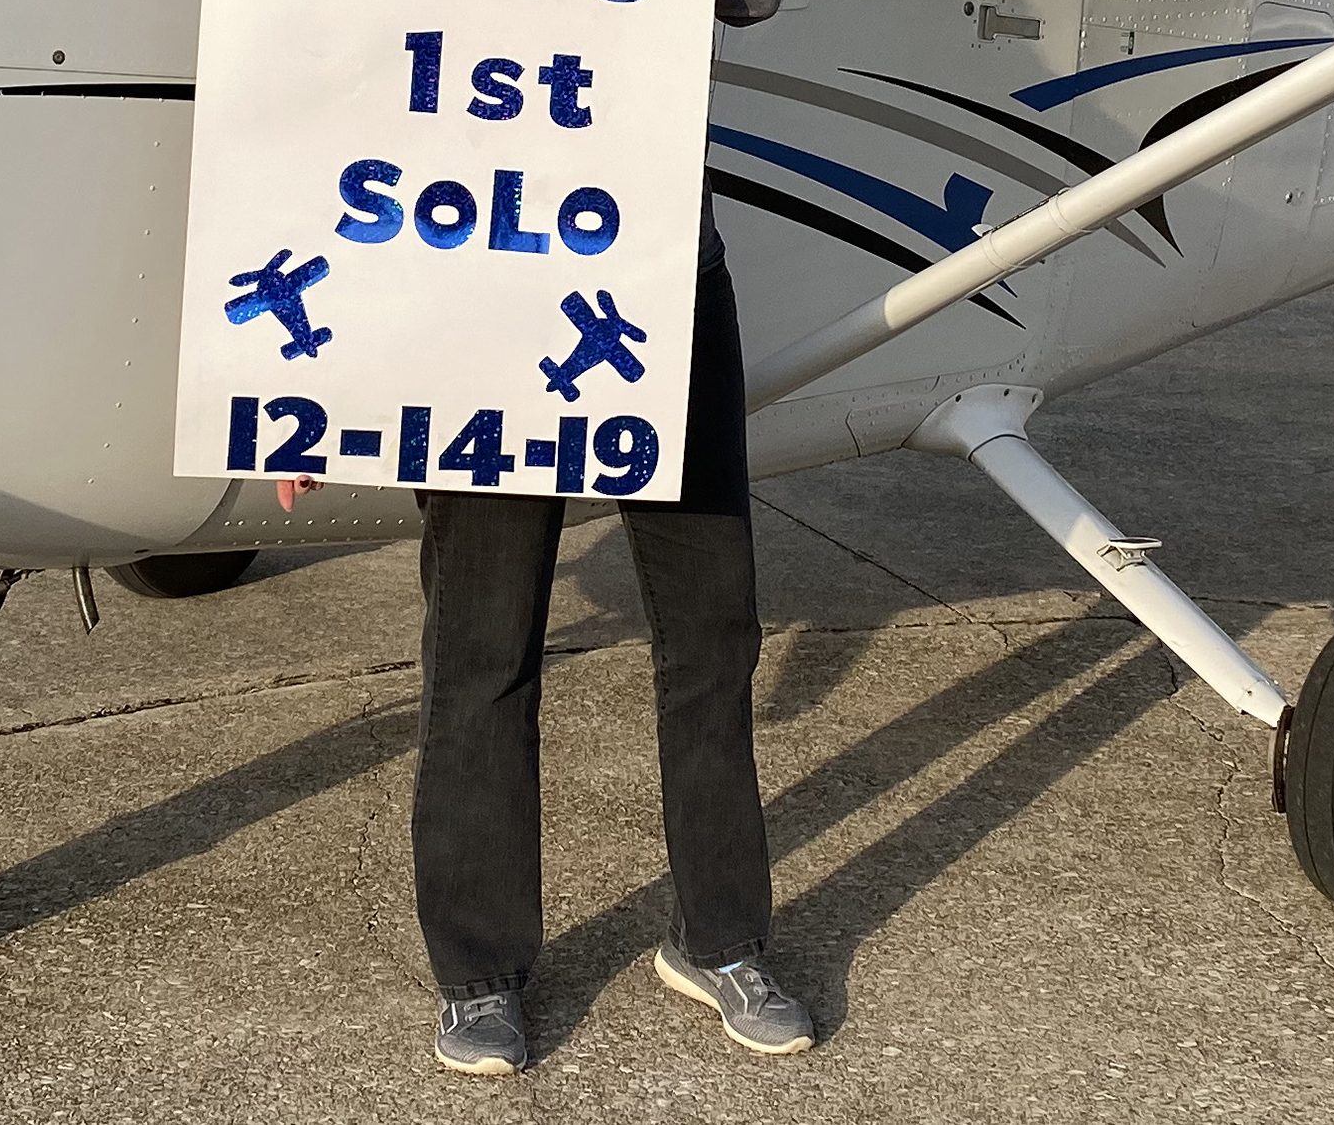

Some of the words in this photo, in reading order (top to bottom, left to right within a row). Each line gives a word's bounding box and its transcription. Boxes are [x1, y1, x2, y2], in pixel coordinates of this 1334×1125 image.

[405, 30, 594, 129] 1st
[334, 158, 621, 256] SoLo
[226, 396, 660, 496] 12-14-19
